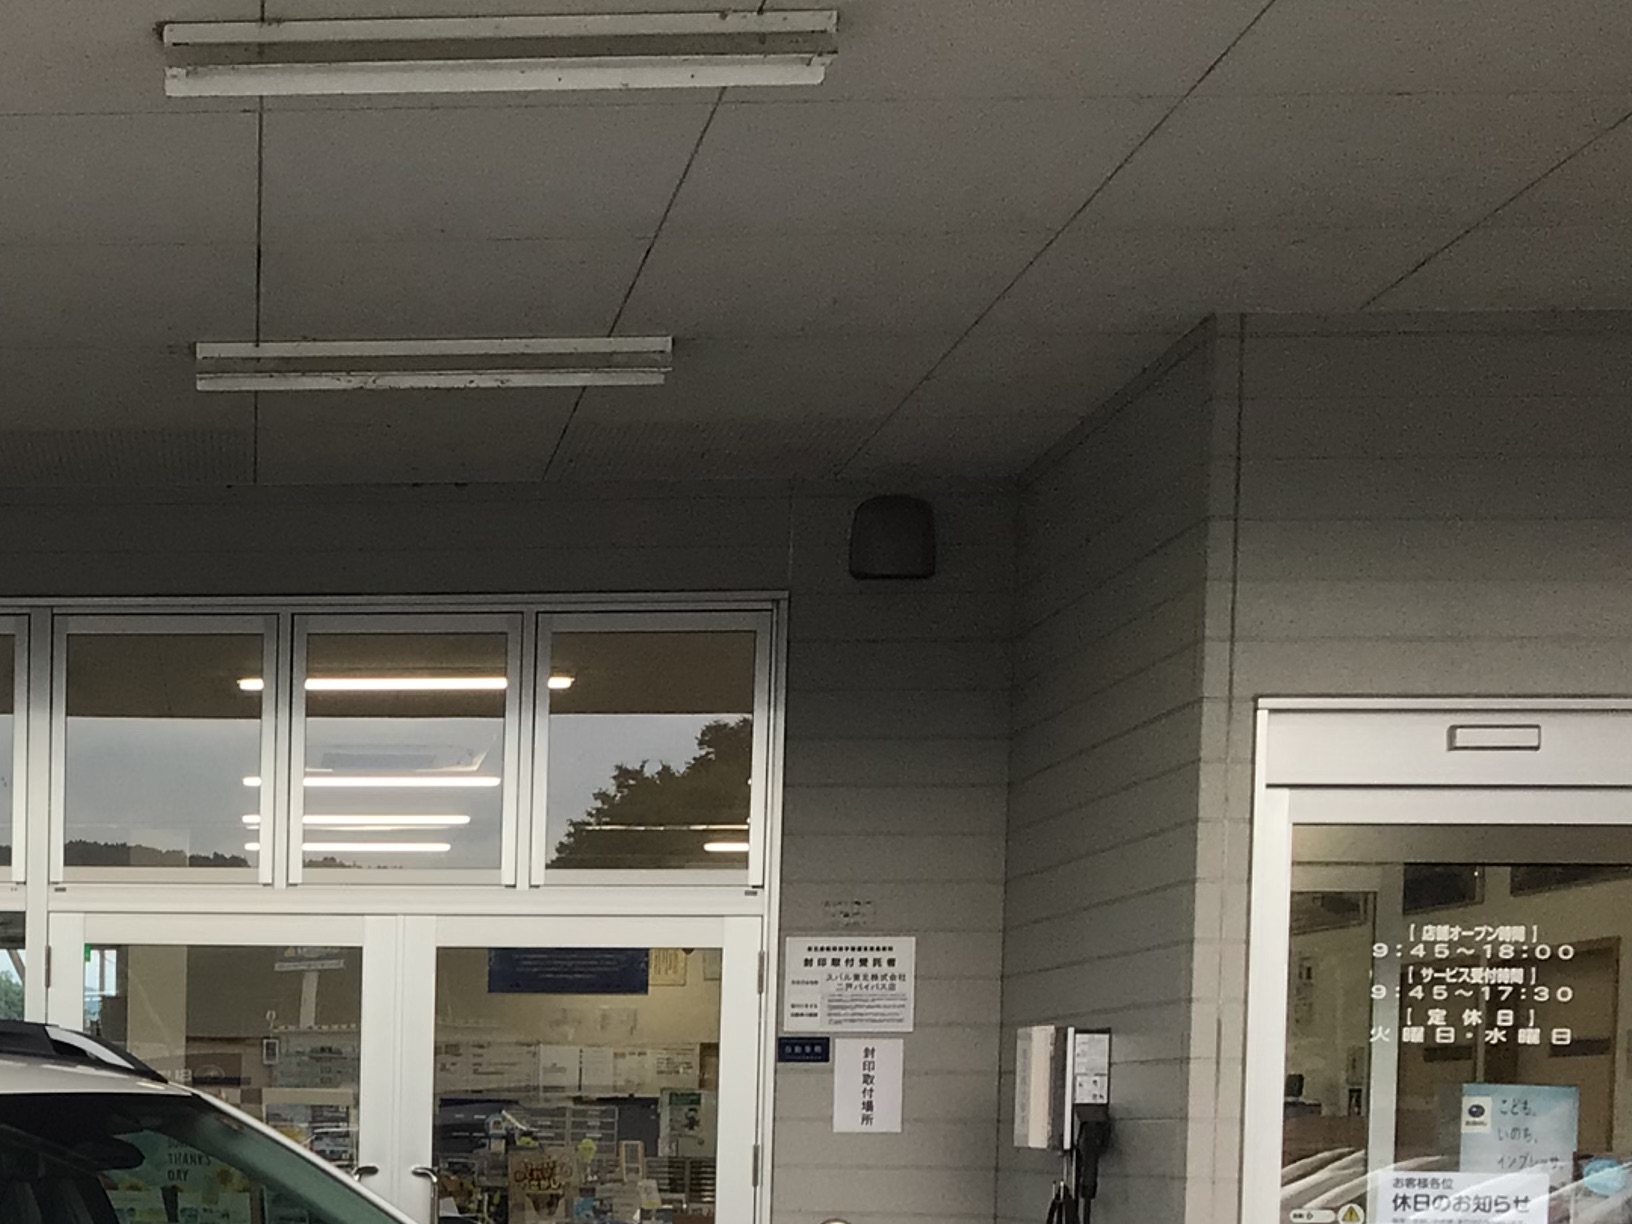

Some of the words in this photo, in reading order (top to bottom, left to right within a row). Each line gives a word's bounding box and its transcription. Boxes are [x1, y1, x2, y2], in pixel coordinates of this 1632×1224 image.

[1392, 1193, 1531, 1214] 休日のお知らせ
